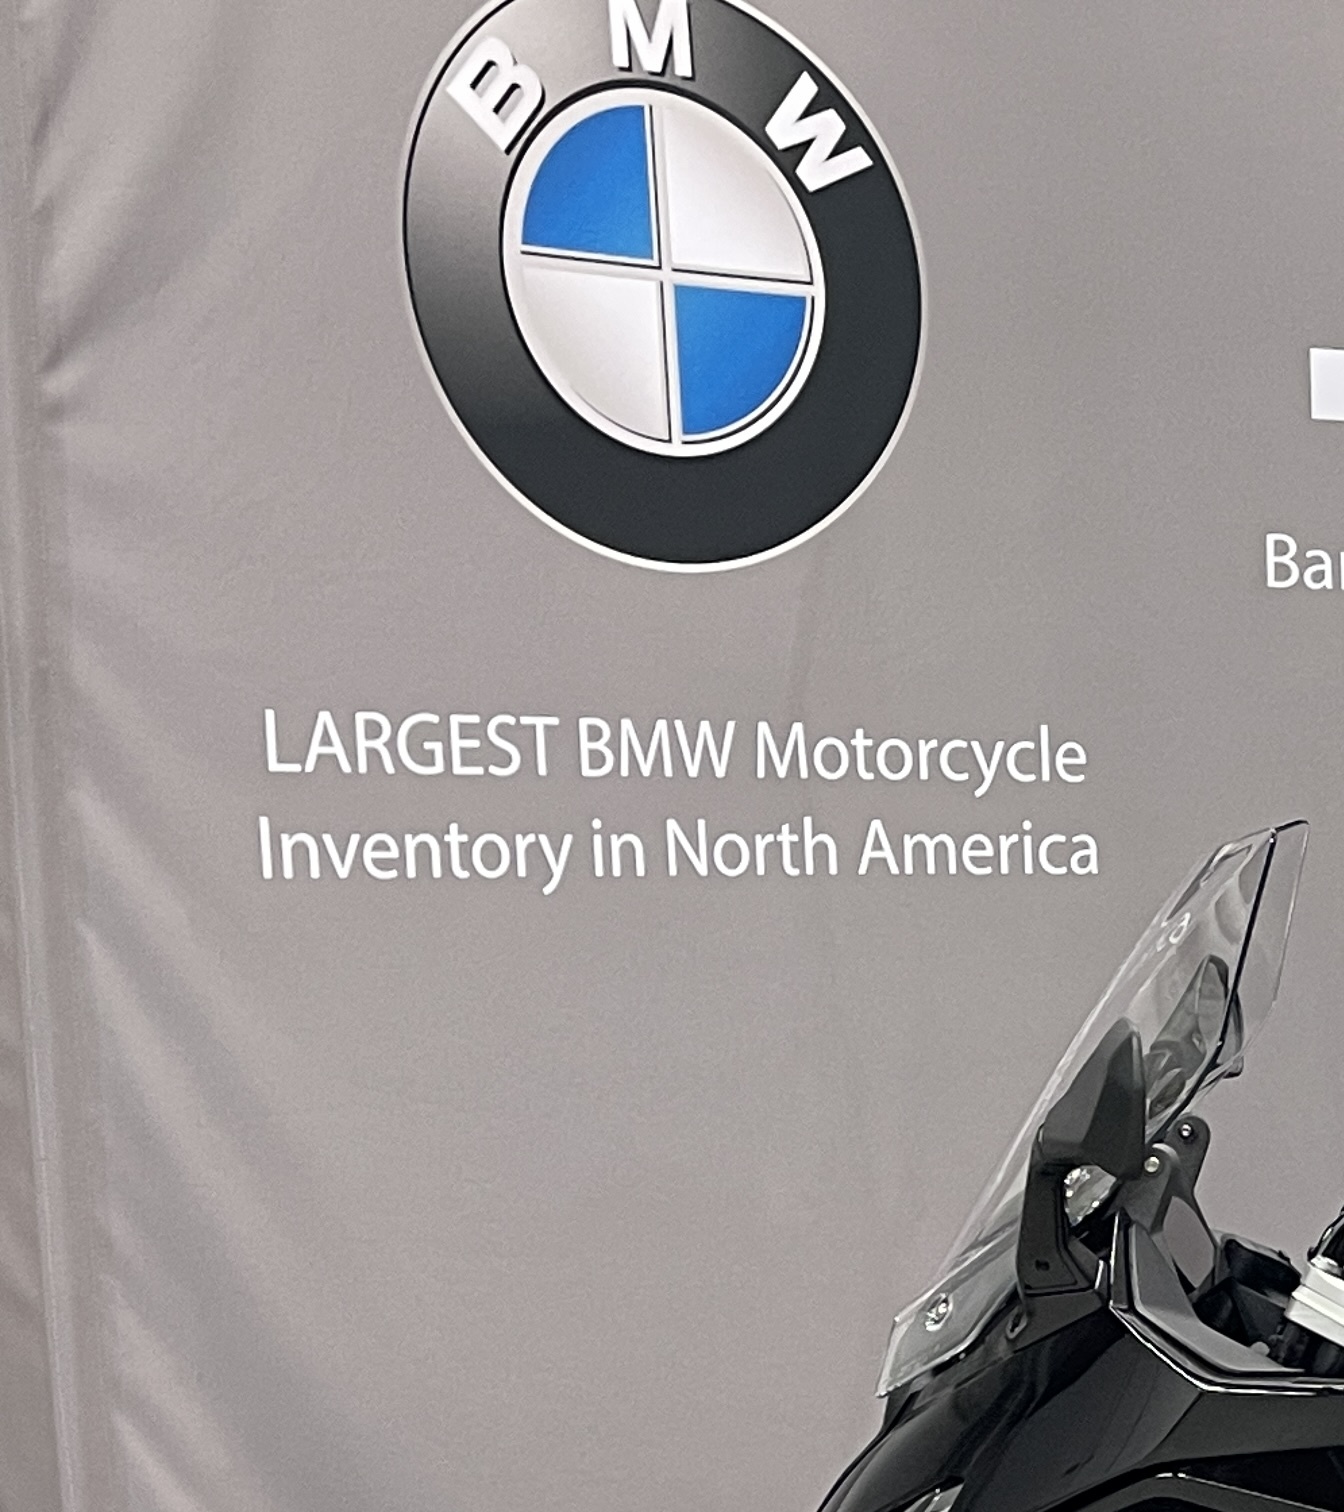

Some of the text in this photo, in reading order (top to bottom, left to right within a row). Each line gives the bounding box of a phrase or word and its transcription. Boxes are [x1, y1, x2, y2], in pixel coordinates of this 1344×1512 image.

[446, 0, 874, 194] BMW
[264, 708, 1088, 798] LARGEST BMW Motorcycle
[258, 816, 1099, 896] Inventory in North America
